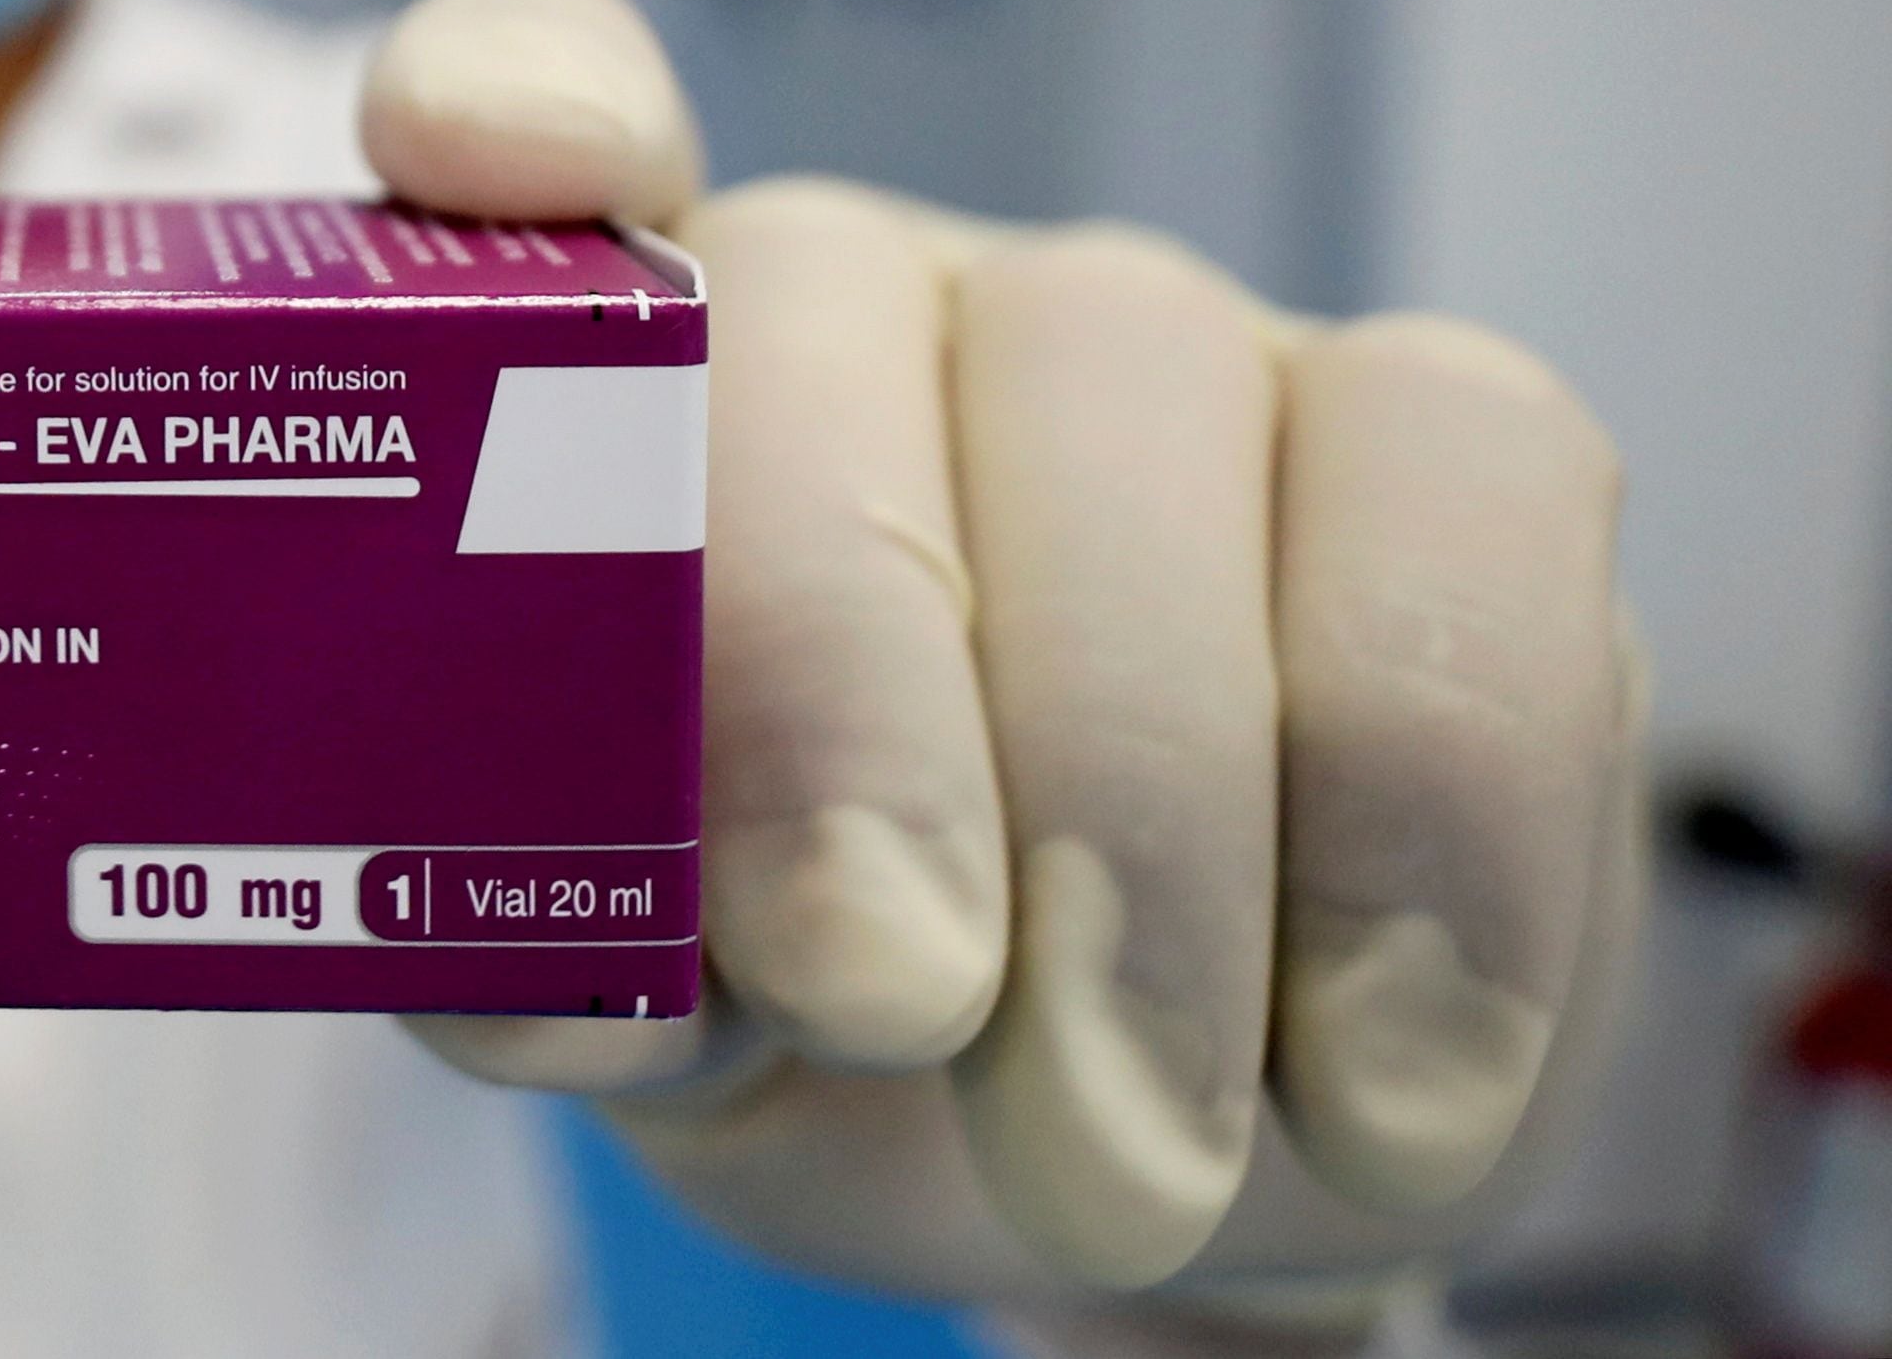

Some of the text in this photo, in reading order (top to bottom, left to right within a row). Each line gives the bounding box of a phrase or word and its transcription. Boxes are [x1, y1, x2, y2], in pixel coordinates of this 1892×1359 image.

[26, 366, 66, 393] for
[75, 366, 190, 392] solution
[199, 365, 240, 392] for
[250, 365, 280, 391] IV
[291, 364, 406, 391] infusion
[37, 416, 147, 464] EVA
[164, 415, 416, 464] PHARMA
[57, 627, 99, 664] IN
[99, 863, 322, 931] 100 mg
[387, 874, 652, 920] 1 Vial 20 ml
